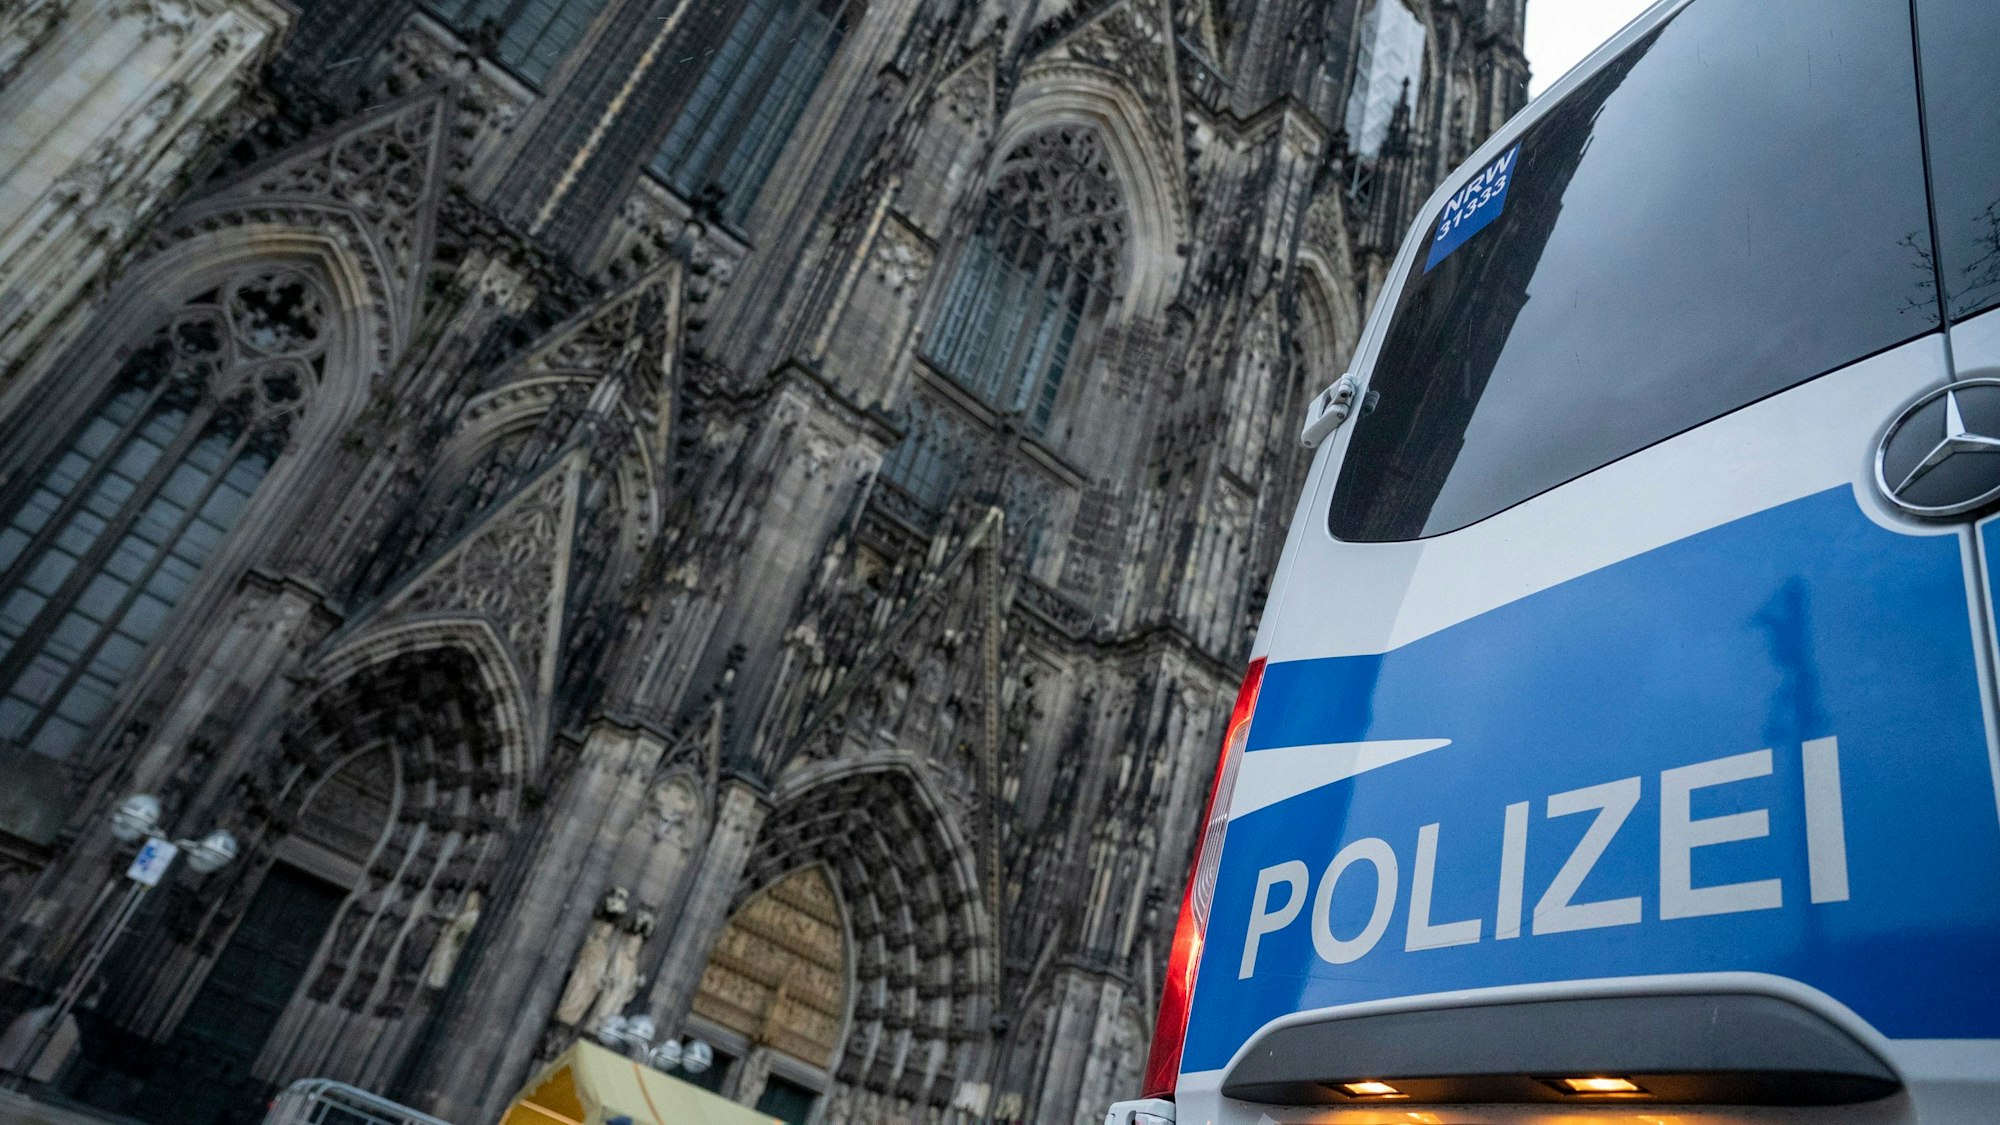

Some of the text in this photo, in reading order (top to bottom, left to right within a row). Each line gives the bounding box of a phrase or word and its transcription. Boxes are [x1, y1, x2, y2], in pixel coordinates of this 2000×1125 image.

[1437, 174, 1507, 241] 31333
[1443, 147, 1516, 221] NRW
[1238, 736, 1850, 980] POLIZEI
